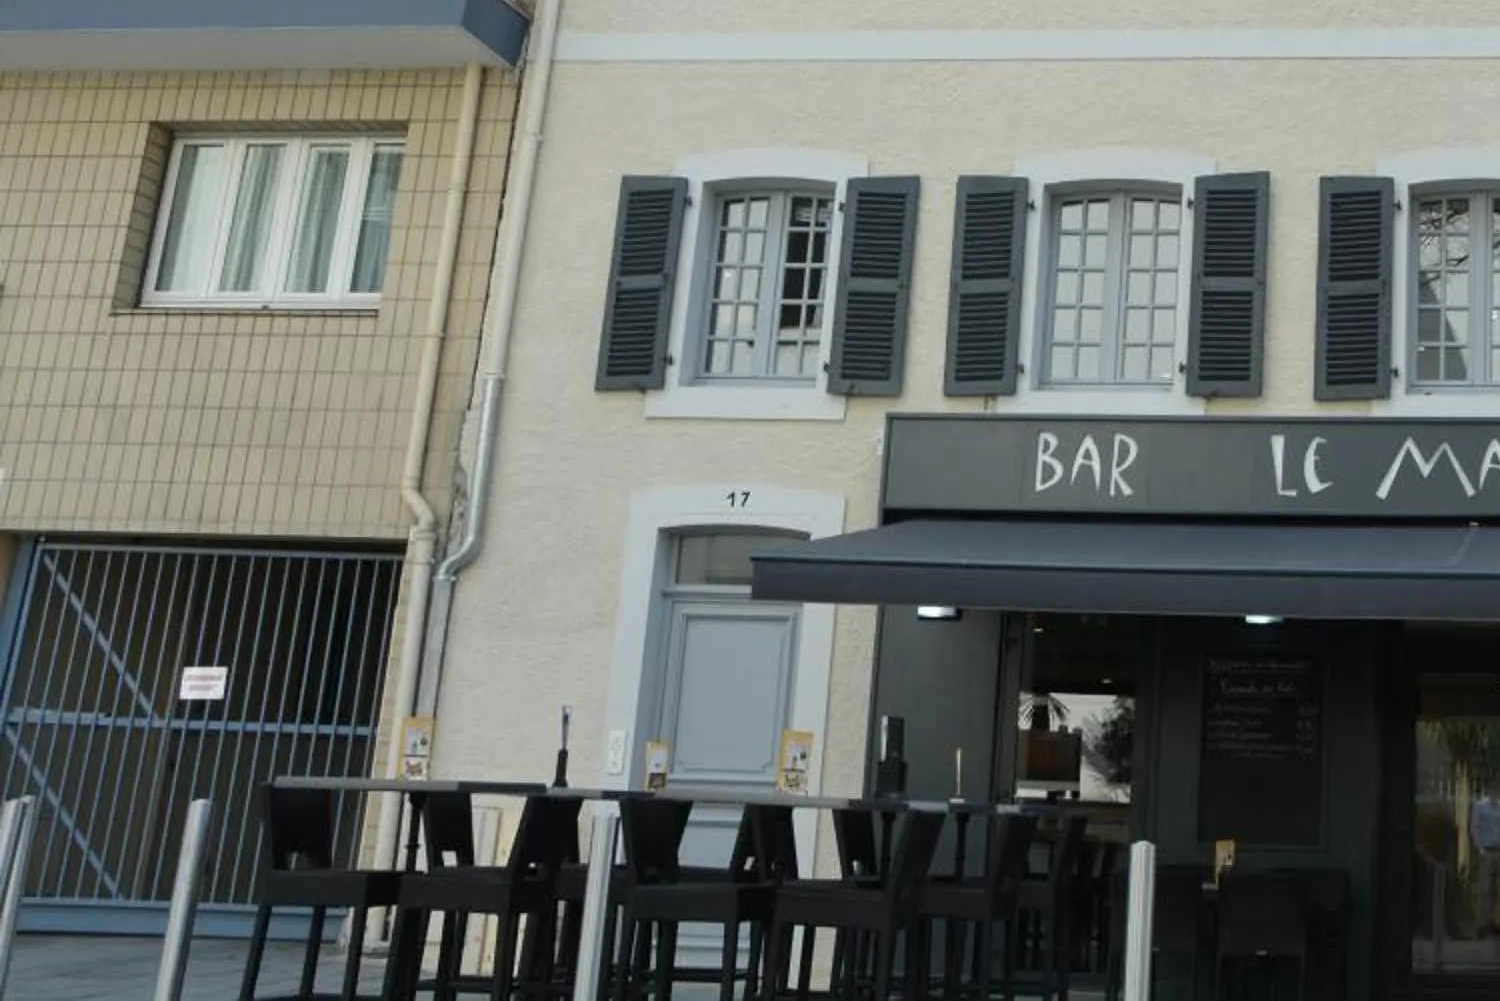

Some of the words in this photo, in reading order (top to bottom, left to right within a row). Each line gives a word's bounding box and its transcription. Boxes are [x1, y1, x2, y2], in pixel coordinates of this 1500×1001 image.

[1034, 431, 1139, 497] BAR
[1271, 434, 1332, 497] LE
[726, 490, 752, 508] 17
